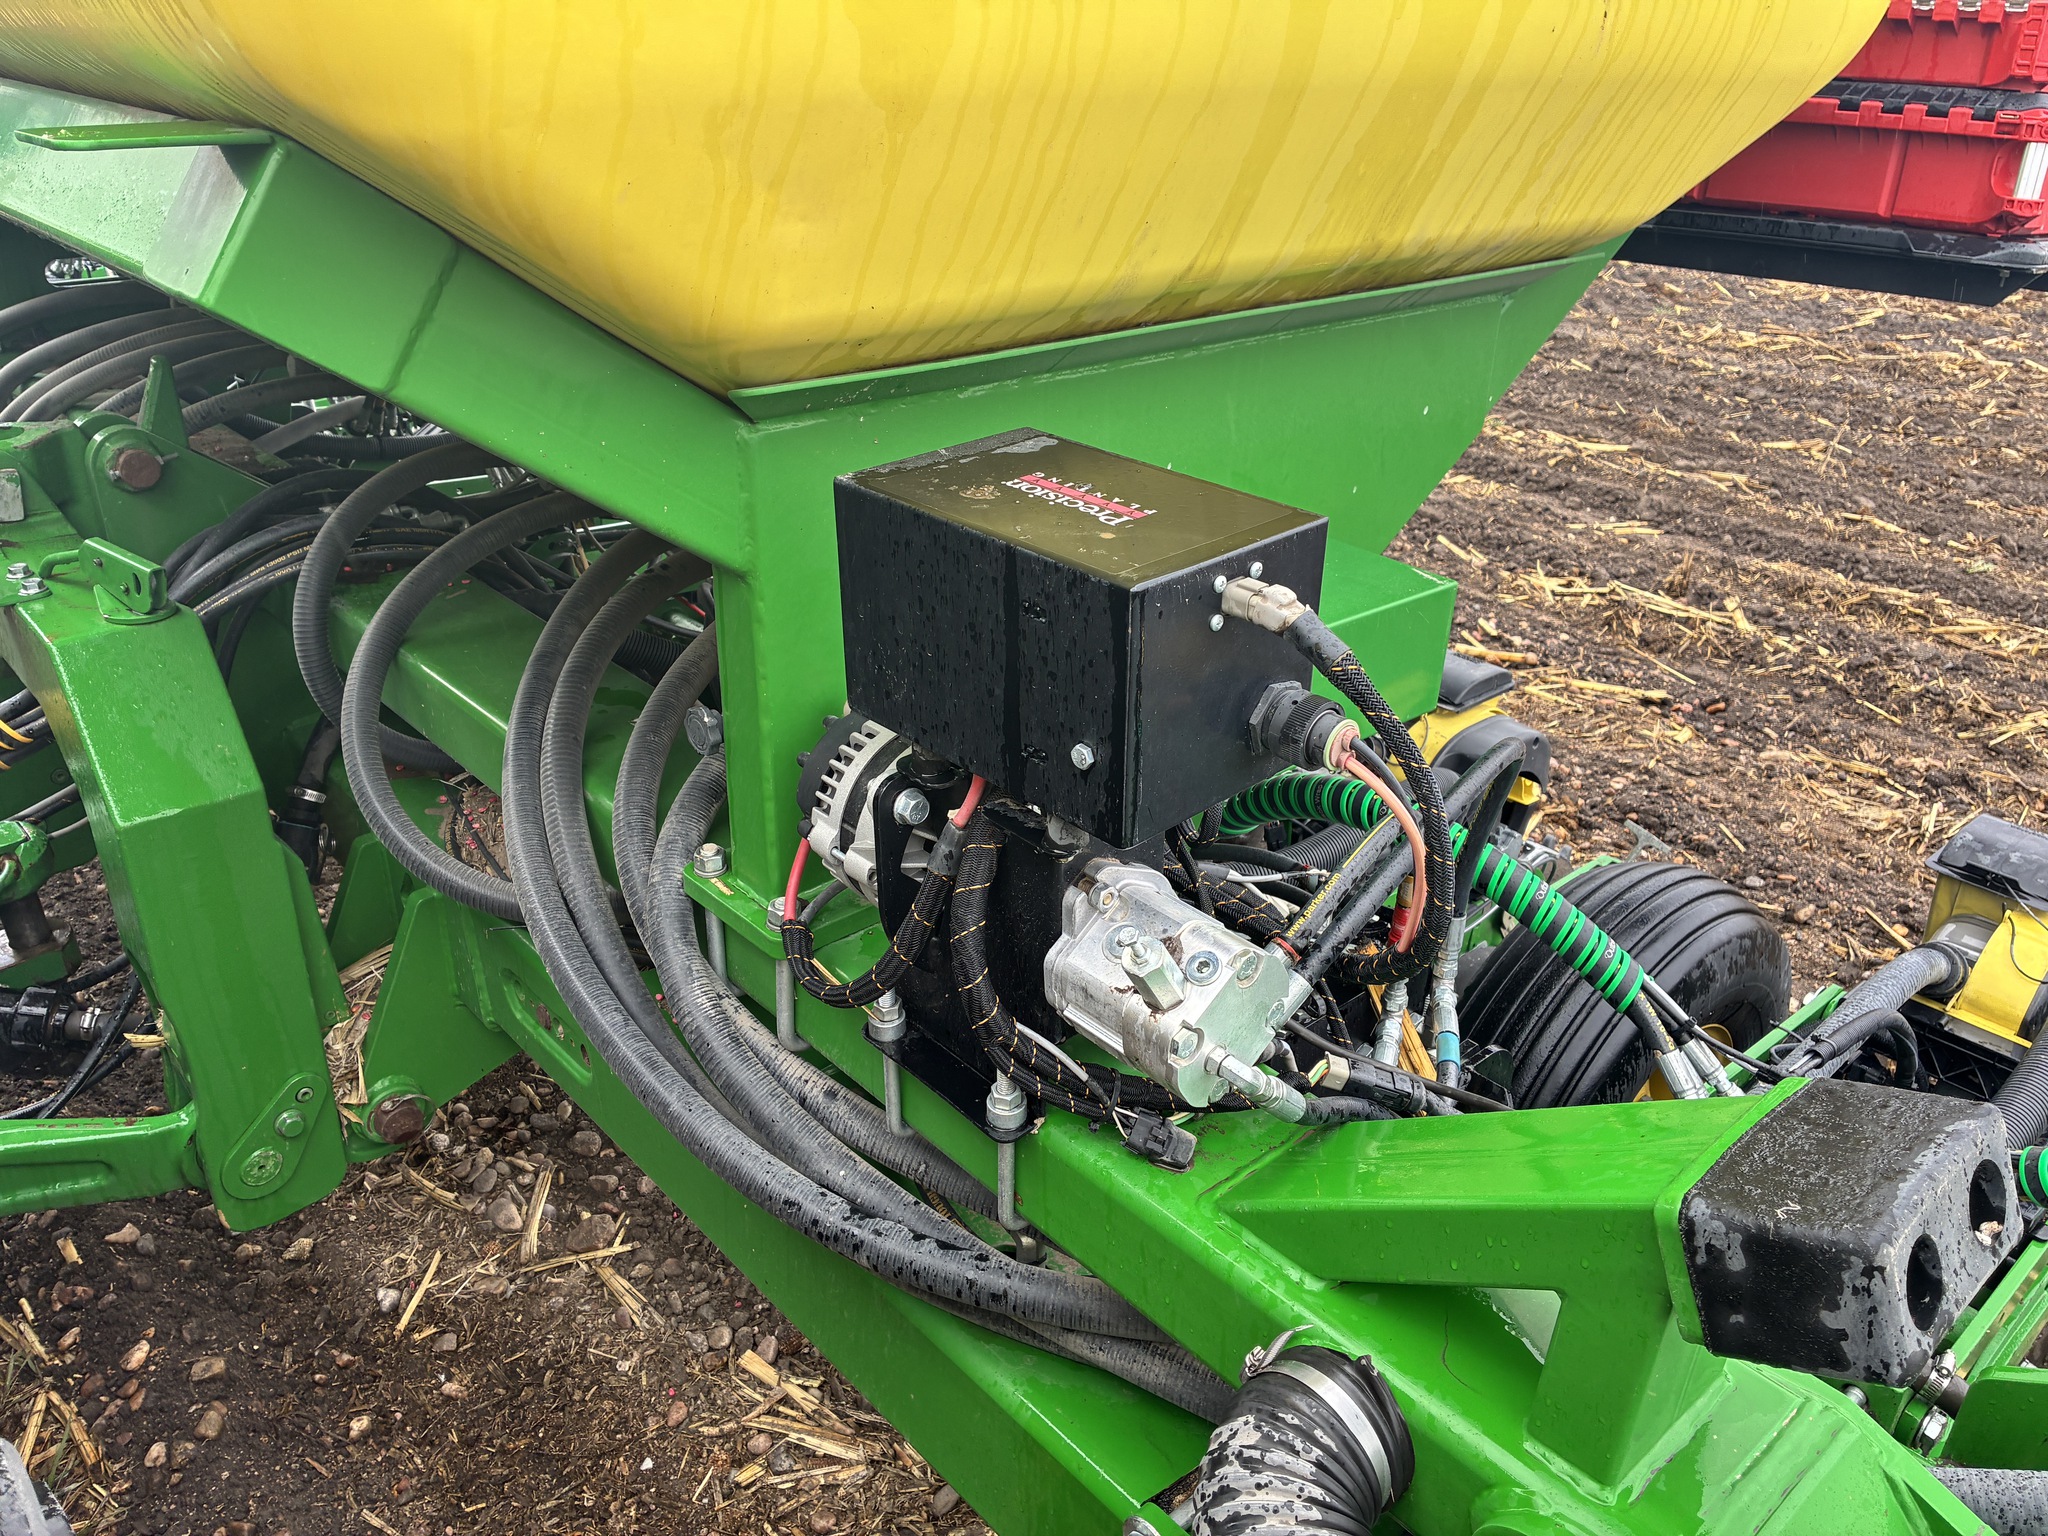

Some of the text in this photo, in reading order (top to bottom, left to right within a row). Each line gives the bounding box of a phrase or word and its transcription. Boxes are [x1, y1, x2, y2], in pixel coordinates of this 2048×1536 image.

[1006, 478, 1133, 526] Precision
[1032, 471, 1157, 515] PLANTING
[1286, 872, 1342, 938] www.parker.com
